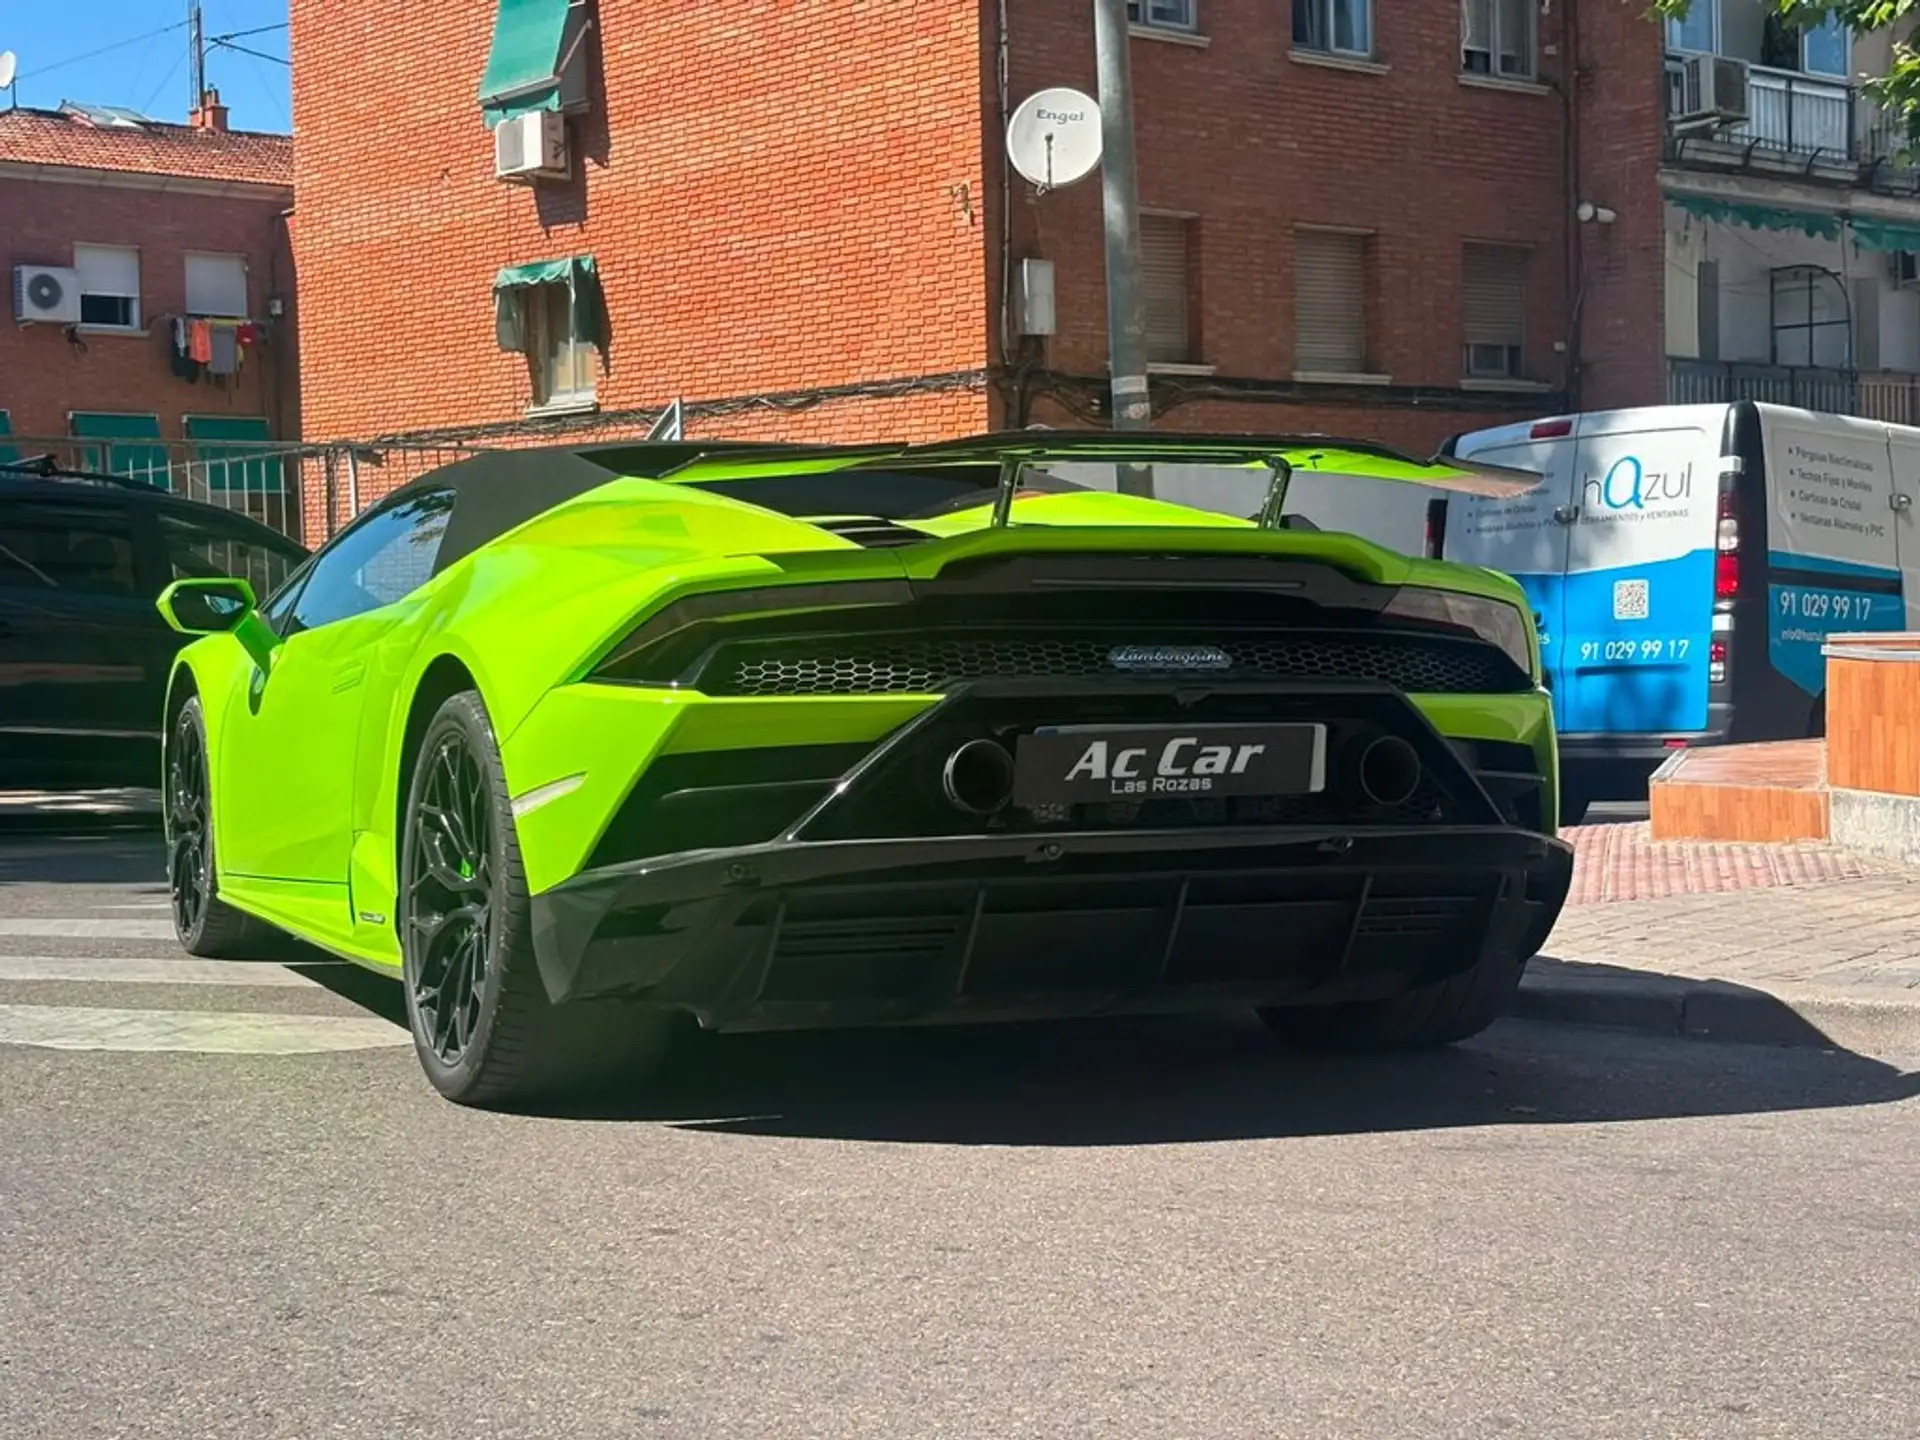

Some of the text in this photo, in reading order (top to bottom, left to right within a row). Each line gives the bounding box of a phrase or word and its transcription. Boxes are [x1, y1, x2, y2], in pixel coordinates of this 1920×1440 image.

[1781, 591, 1872, 622] 91 029 99 17
[1580, 638, 1690, 661] 91 029 99 17
[1064, 737, 1266, 781] Ac Car
[1111, 776, 1213, 794] Las Rozas
